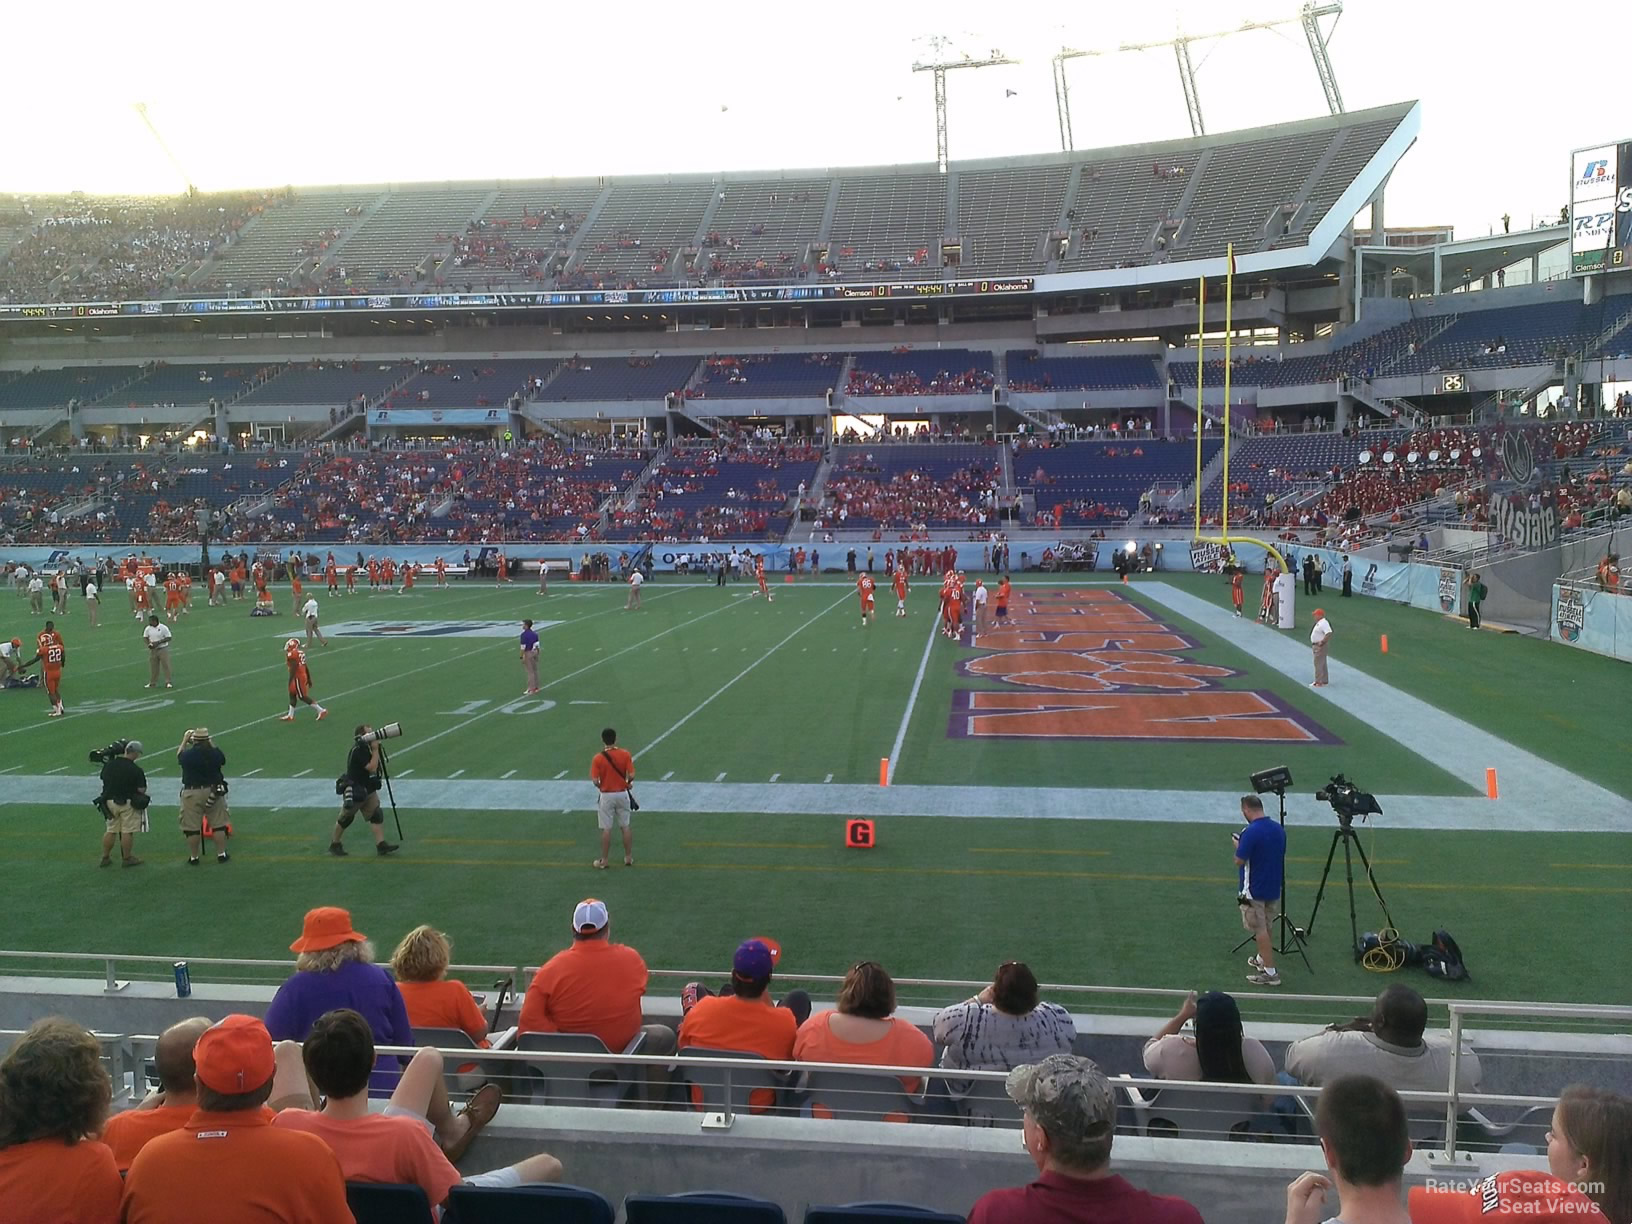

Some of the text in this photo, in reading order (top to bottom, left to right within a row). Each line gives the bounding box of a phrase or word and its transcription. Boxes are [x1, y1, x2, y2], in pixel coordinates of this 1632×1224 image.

[993, 283, 1028, 291] Oklahoma
[1445, 376, 1461, 390] 25
[1488, 492, 1555, 547] Allstate
[951, 590, 960, 600] 40
[48, 648, 62, 662] 22
[435, 699, 557, 715] 10
[850, 822, 870, 845] G
